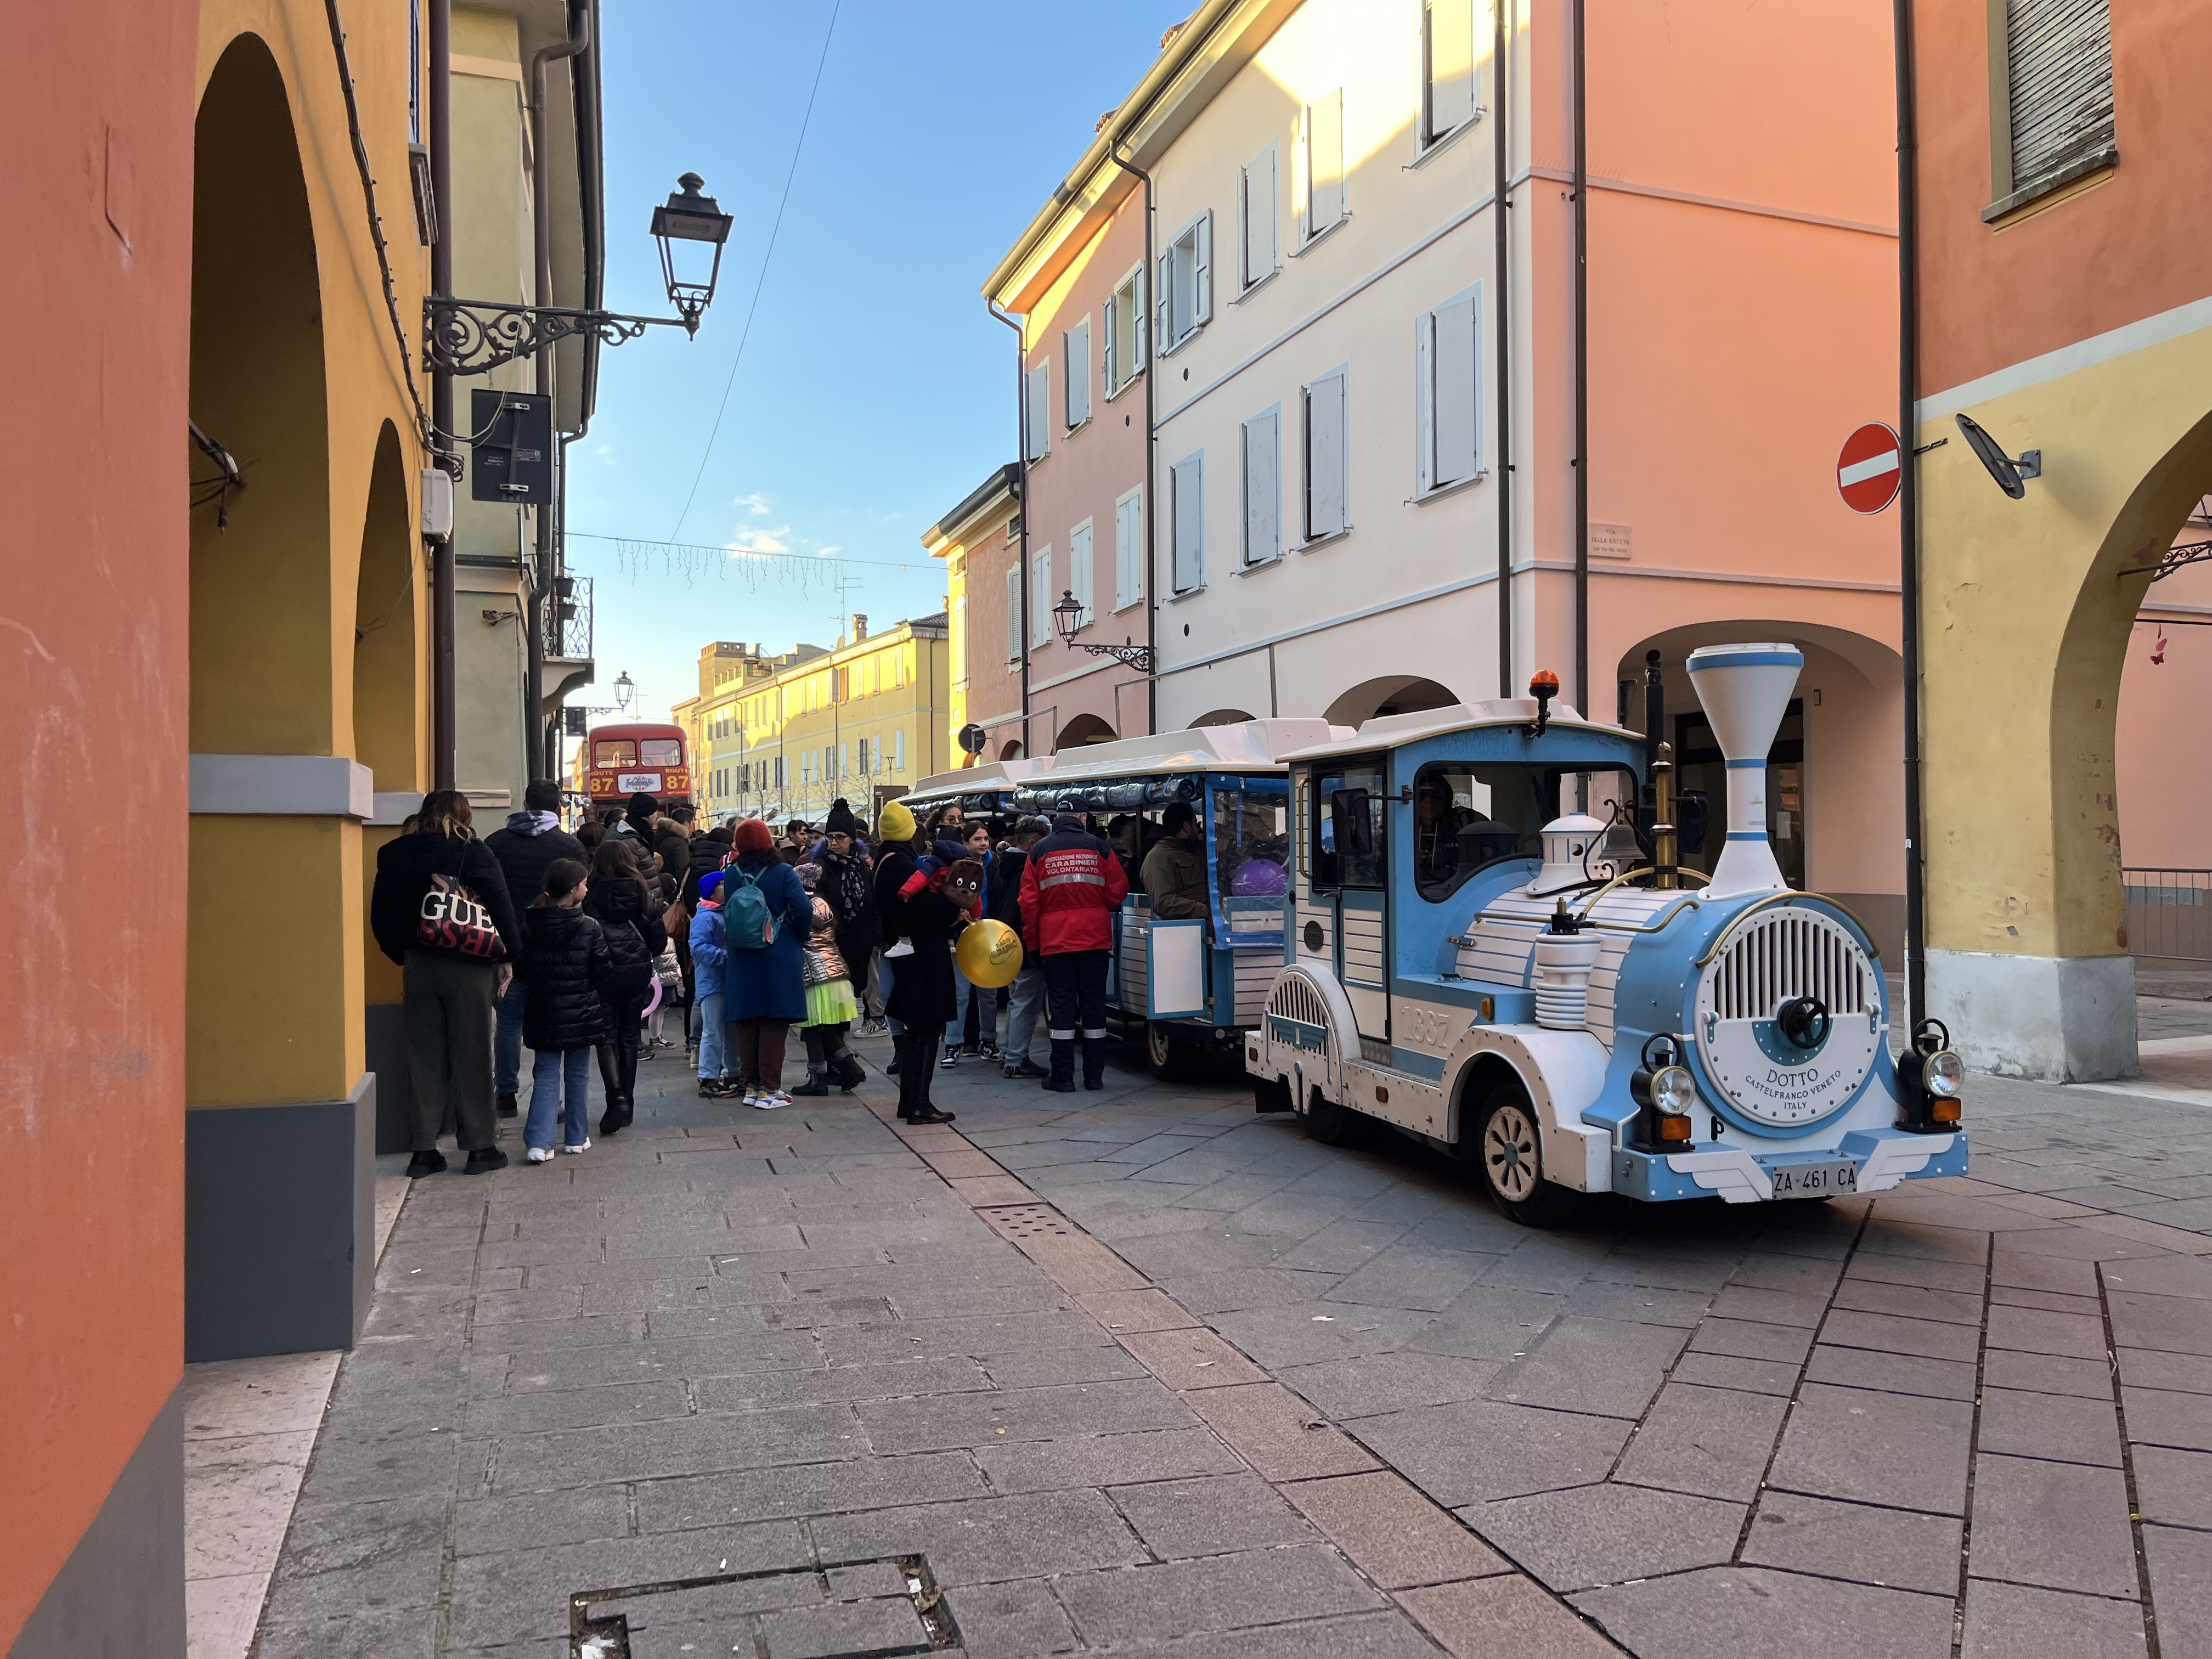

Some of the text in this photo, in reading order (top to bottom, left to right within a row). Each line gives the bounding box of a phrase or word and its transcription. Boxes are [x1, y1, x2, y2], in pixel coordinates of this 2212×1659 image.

[590, 778, 614, 792] 87
[667, 776, 689, 789] 87
[1045, 860, 1098, 869] CARABINIERI
[420, 891, 499, 936] GUE
[1401, 1006, 1449, 1049] 1887
[1746, 1070, 1841, 1100] CASTELFRANCO VENETO
[1766, 1068, 1818, 1087] DOTTO
[1784, 1101, 1807, 1110] ITALY
[1774, 1167, 1855, 1191] ZA 461 CA
